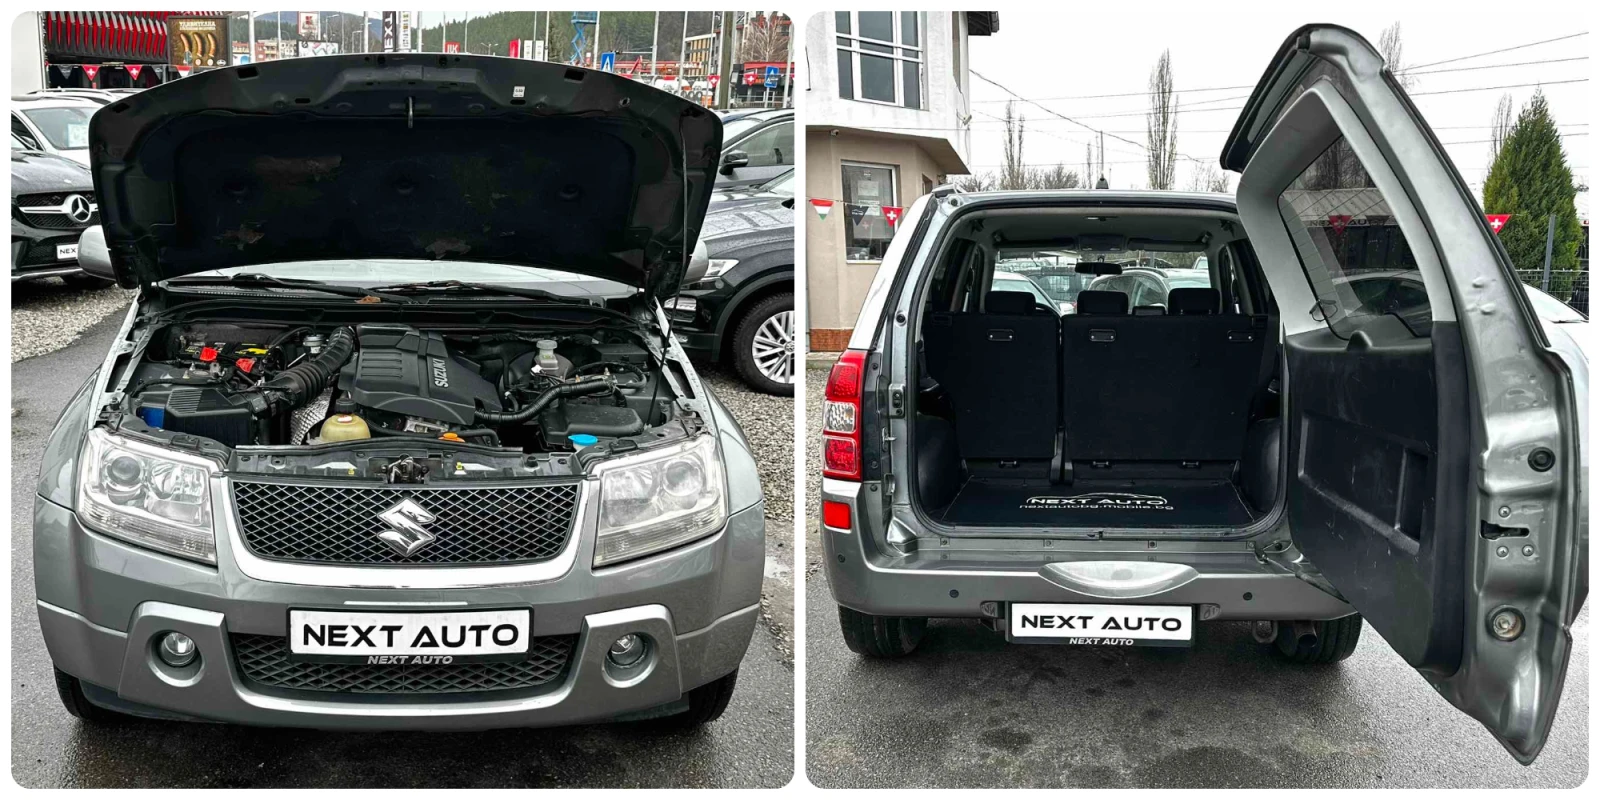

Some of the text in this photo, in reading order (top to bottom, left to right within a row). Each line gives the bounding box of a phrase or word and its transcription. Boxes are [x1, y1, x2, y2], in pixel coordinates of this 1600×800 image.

[433, 358, 448, 387] SUZUKI
[1021, 614, 1182, 632] NEXT AUTO
[303, 623, 519, 648] NEXT AUTO
[1069, 637, 1134, 646] NEXT AUTO
[367, 655, 453, 665] NEXT AUTO
